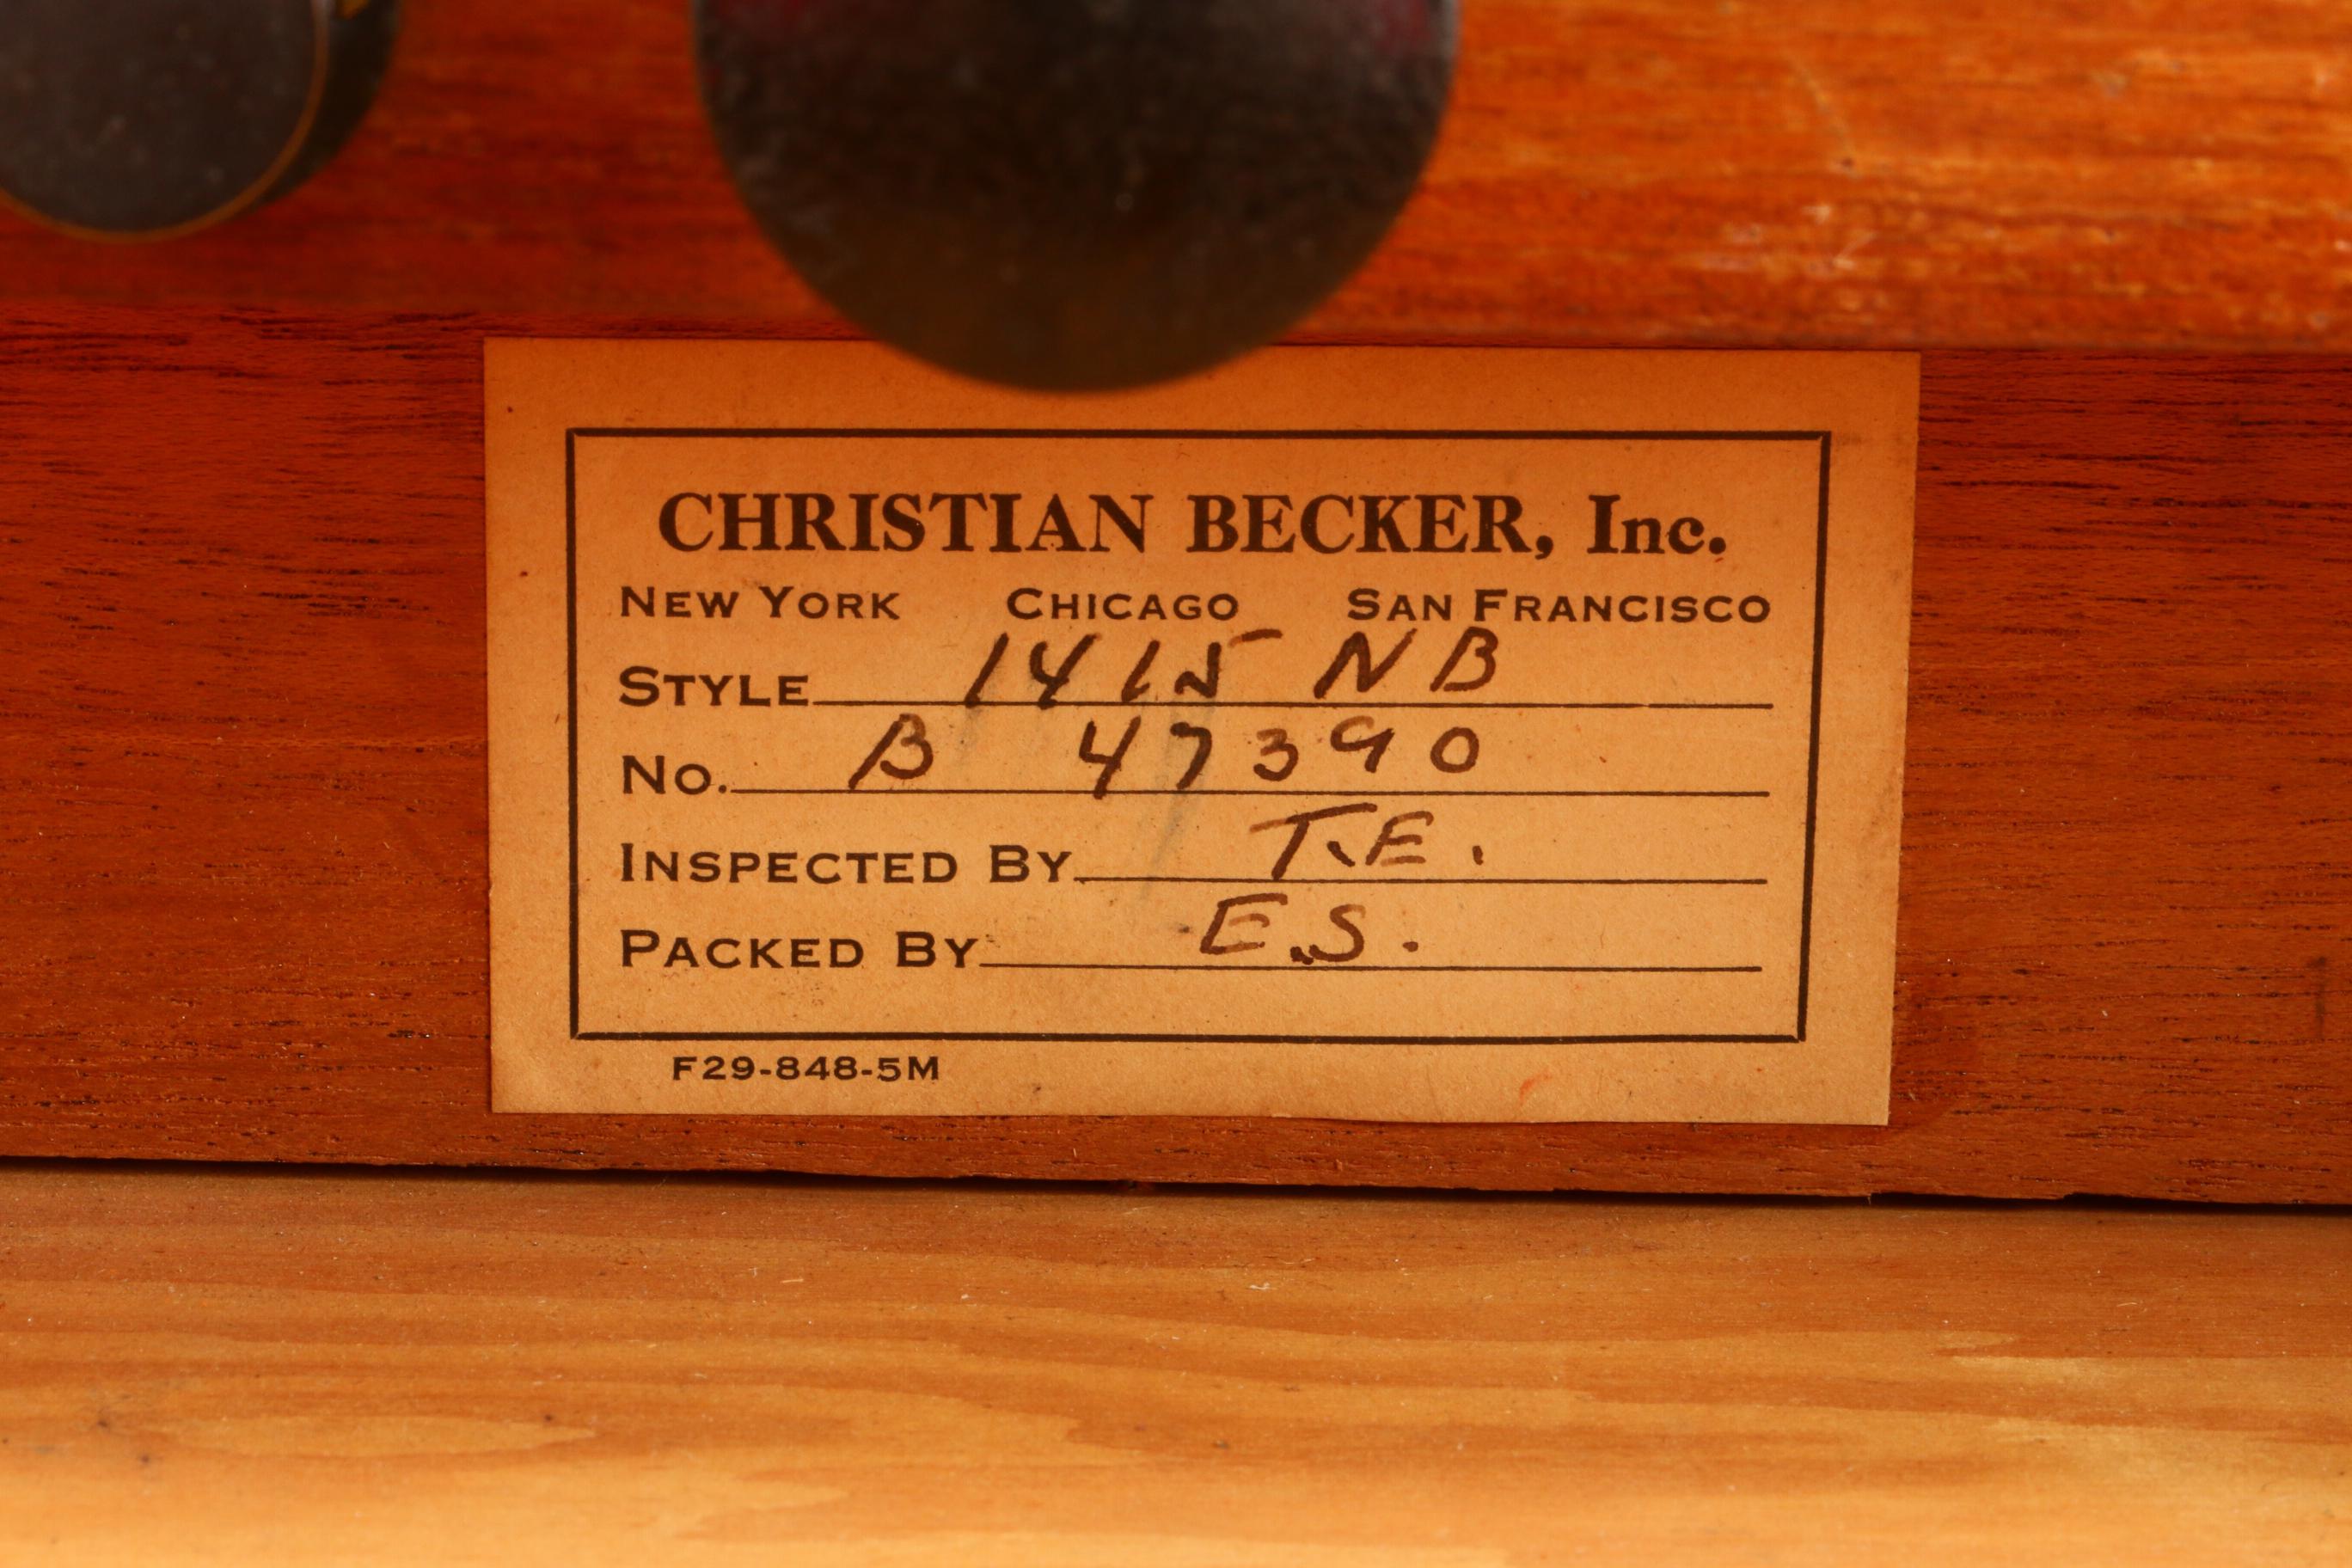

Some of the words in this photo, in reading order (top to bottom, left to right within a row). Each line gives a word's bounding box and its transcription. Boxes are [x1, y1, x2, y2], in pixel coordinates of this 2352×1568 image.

[658, 492, 1154, 554] CHRISTIAN
[1185, 493, 1554, 560] BECKER,
[1586, 493, 1728, 555] Inc.
[620, 585, 739, 618] NEW
[759, 585, 901, 620] YORK
[1006, 587, 1240, 621] CHICAGO
[1347, 588, 1451, 622] SAN
[1473, 590, 1772, 623] FRANCISCO
[618, 666, 810, 707] STYLE
[848, 713, 934, 789] B
[1079, 715, 1479, 799] 47390
[620, 842, 958, 884] INSPECTED
[988, 844, 1073, 883] BY
[620, 929, 865, 969] PACKED
[896, 931, 979, 969] BY
[672, 1056, 940, 1081] F29-848-5M
